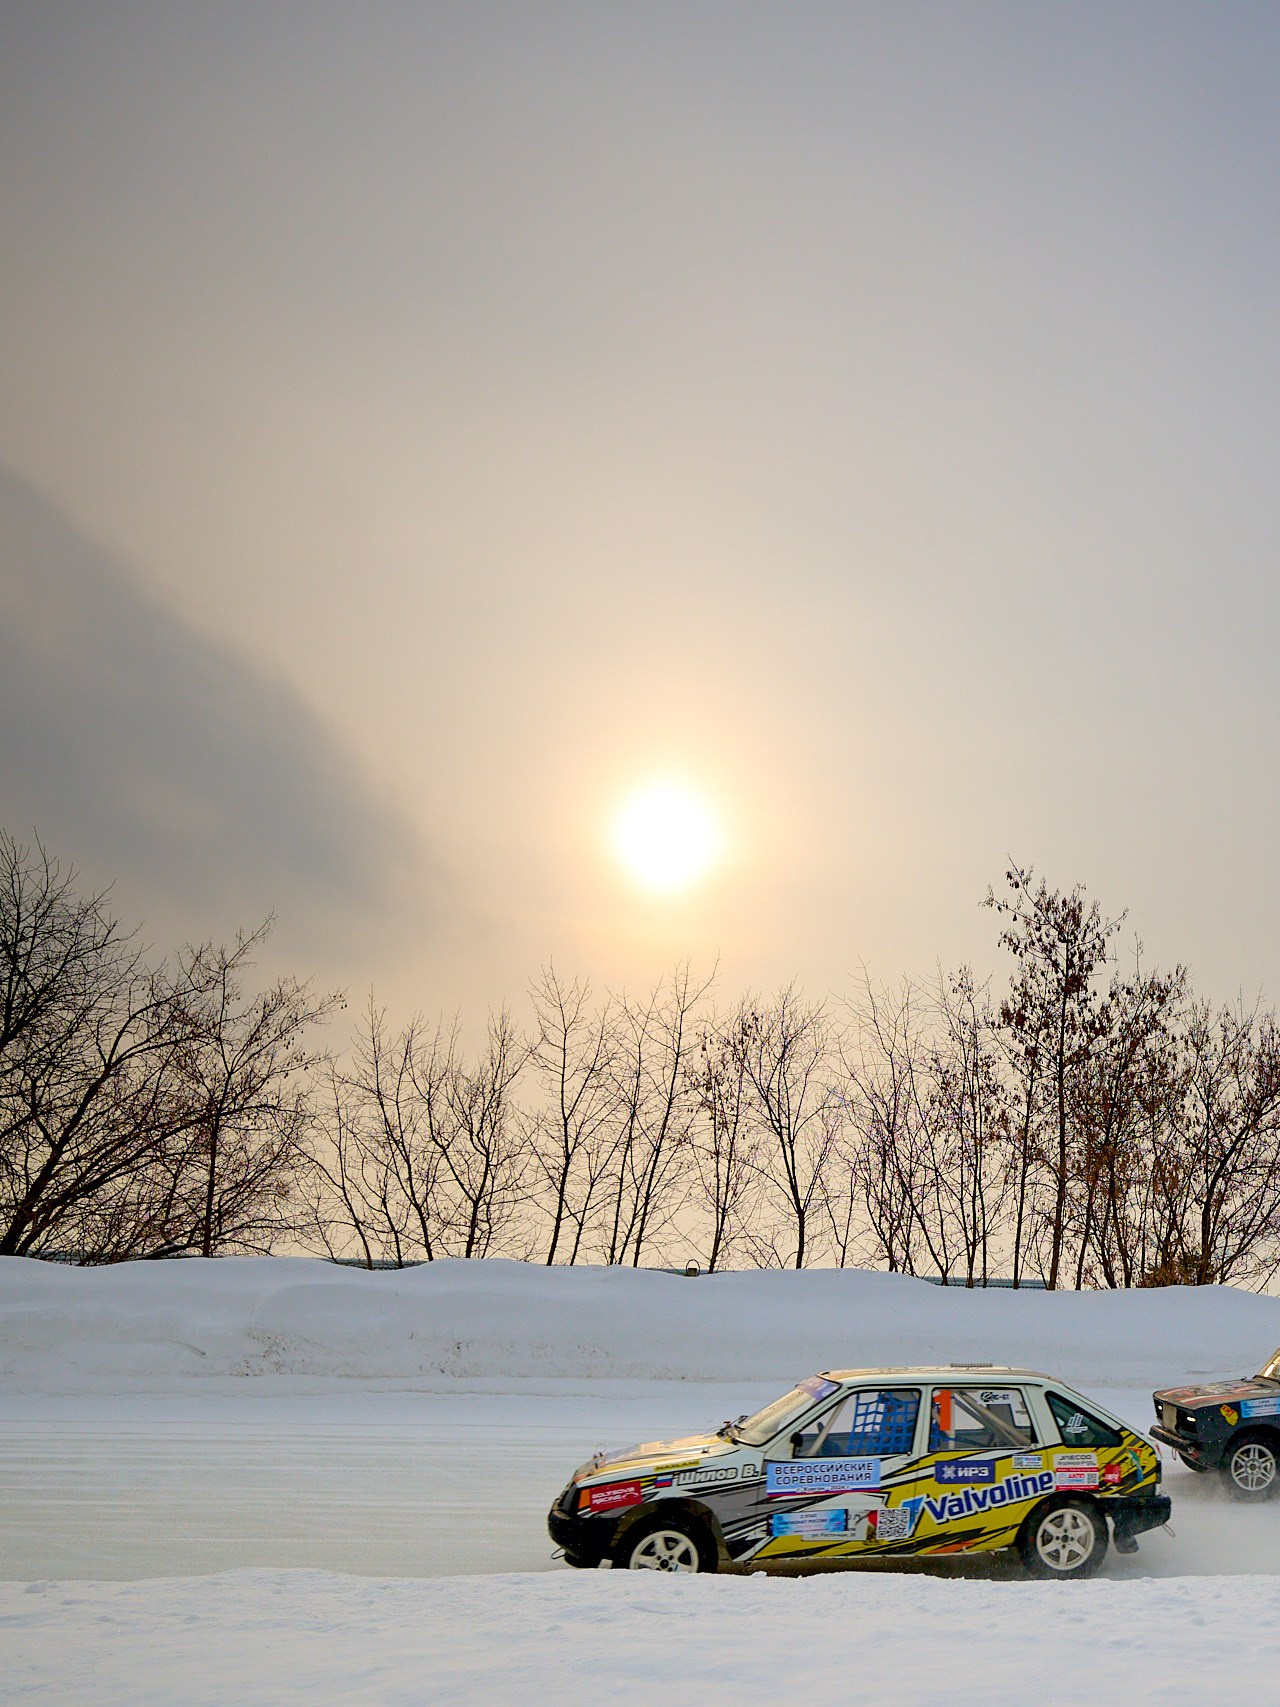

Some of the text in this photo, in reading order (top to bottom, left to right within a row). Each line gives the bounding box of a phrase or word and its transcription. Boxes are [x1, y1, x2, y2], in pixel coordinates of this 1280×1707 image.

[775, 1462, 873, 1475] ВСЕРОССИЙСКИЕ
[957, 1467, 989, 1477] ИРЗ
[677, 1467, 738, 1486] Шилов
[776, 1473, 871, 1485] СОРЕВНОВАНИЯ
[925, 1471, 1054, 1521] Valvoline
